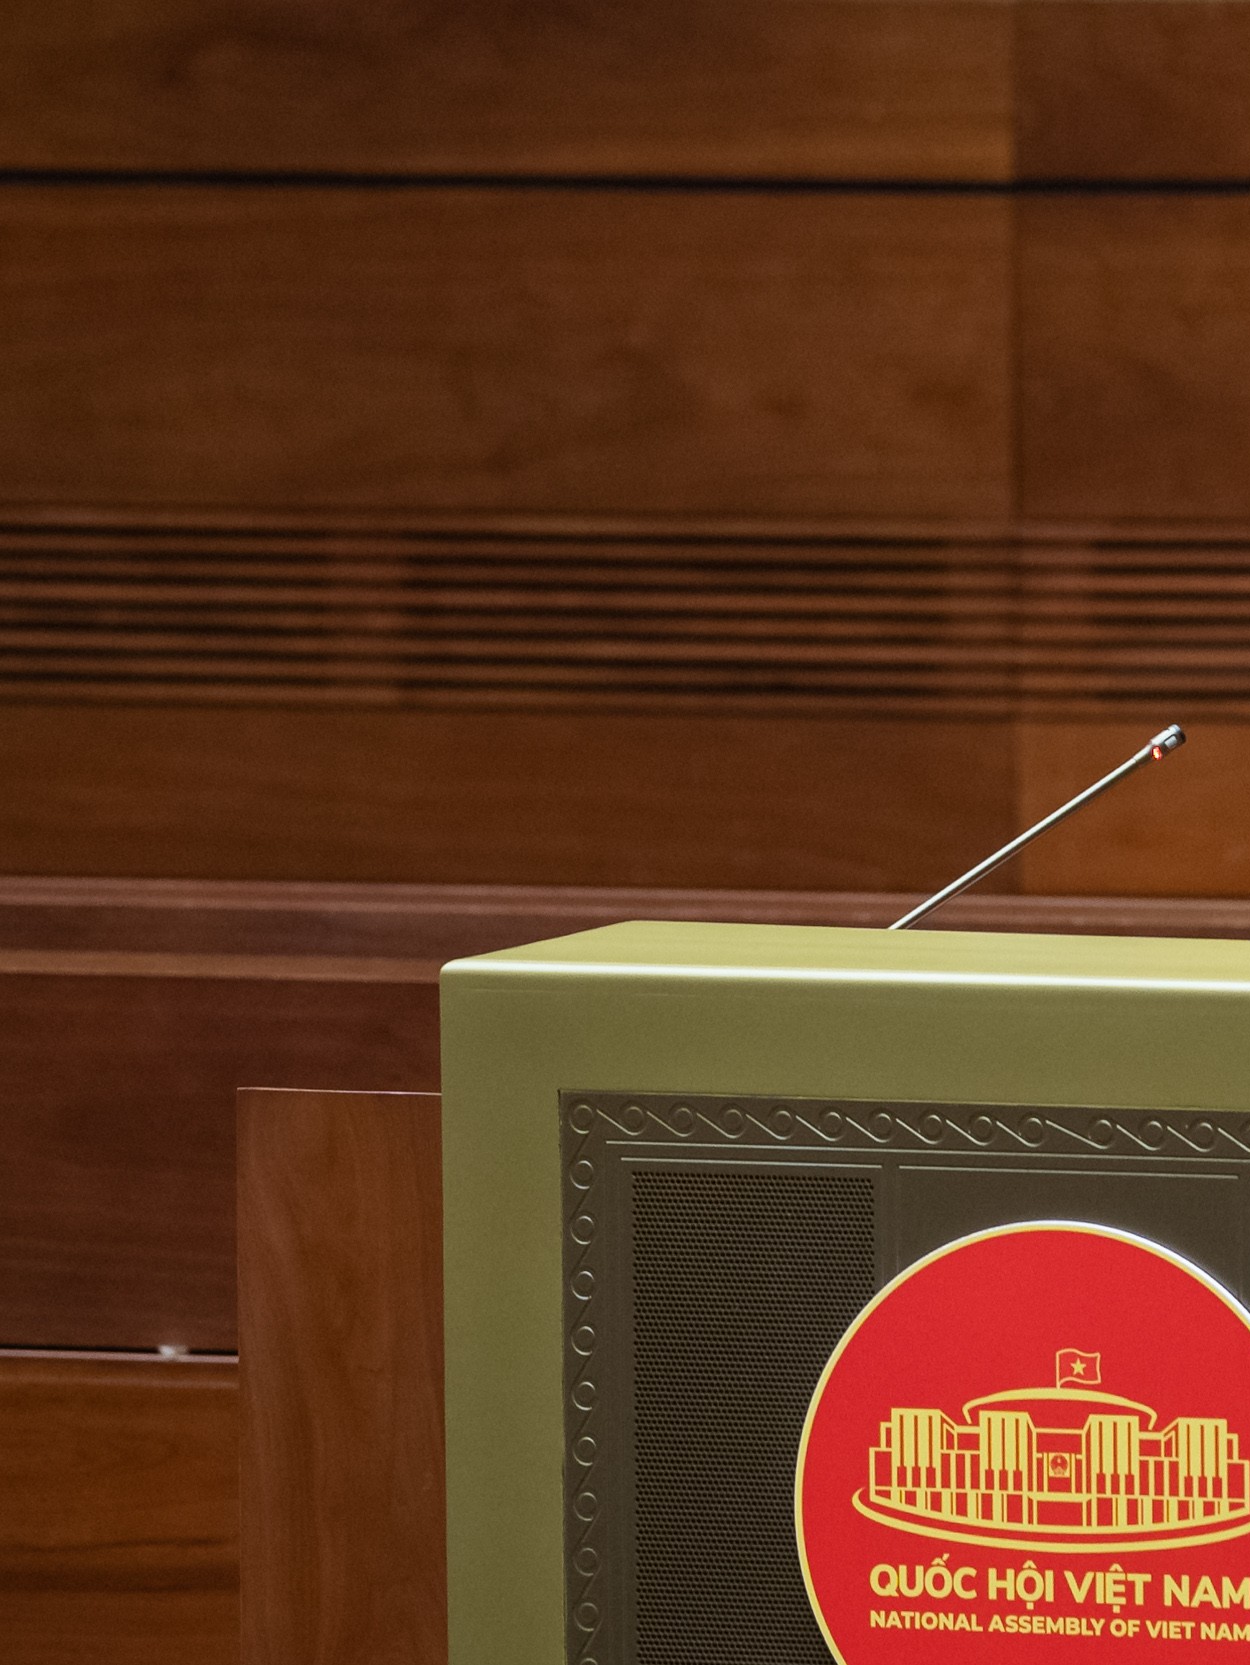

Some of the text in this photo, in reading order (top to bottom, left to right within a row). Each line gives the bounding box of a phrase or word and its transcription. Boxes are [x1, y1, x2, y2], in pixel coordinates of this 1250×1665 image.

[869, 1552, 978, 1600] QUỐC
[987, 1559, 1055, 1611] HỘI
[1063, 1563, 1152, 1614] VIỆT
[870, 1610, 984, 1632] NATIONAL
[987, 1614, 1106, 1636] ASSEMBLY
[1109, 1618, 1141, 1638] OF
[1145, 1619, 1196, 1640] VIET
